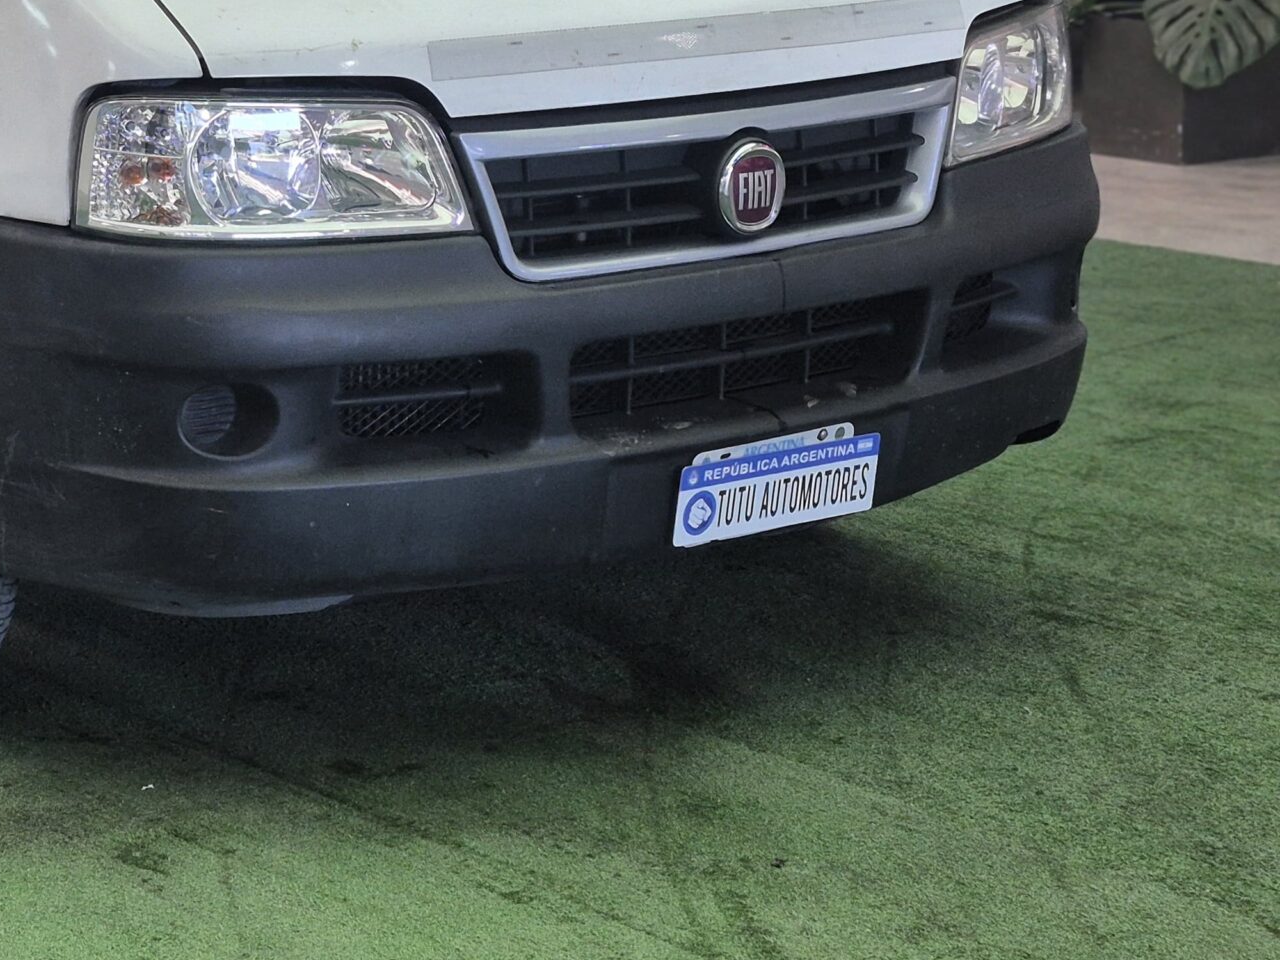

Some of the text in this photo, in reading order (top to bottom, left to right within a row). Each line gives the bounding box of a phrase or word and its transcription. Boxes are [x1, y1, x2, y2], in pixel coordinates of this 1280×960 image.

[738, 169, 774, 211] FIAT
[703, 443, 855, 482] REPÚBLICA ARGENTINA
[743, 436, 805, 457] ARGENTINA
[717, 463, 870, 527] TUTU AUTOMOTORES
